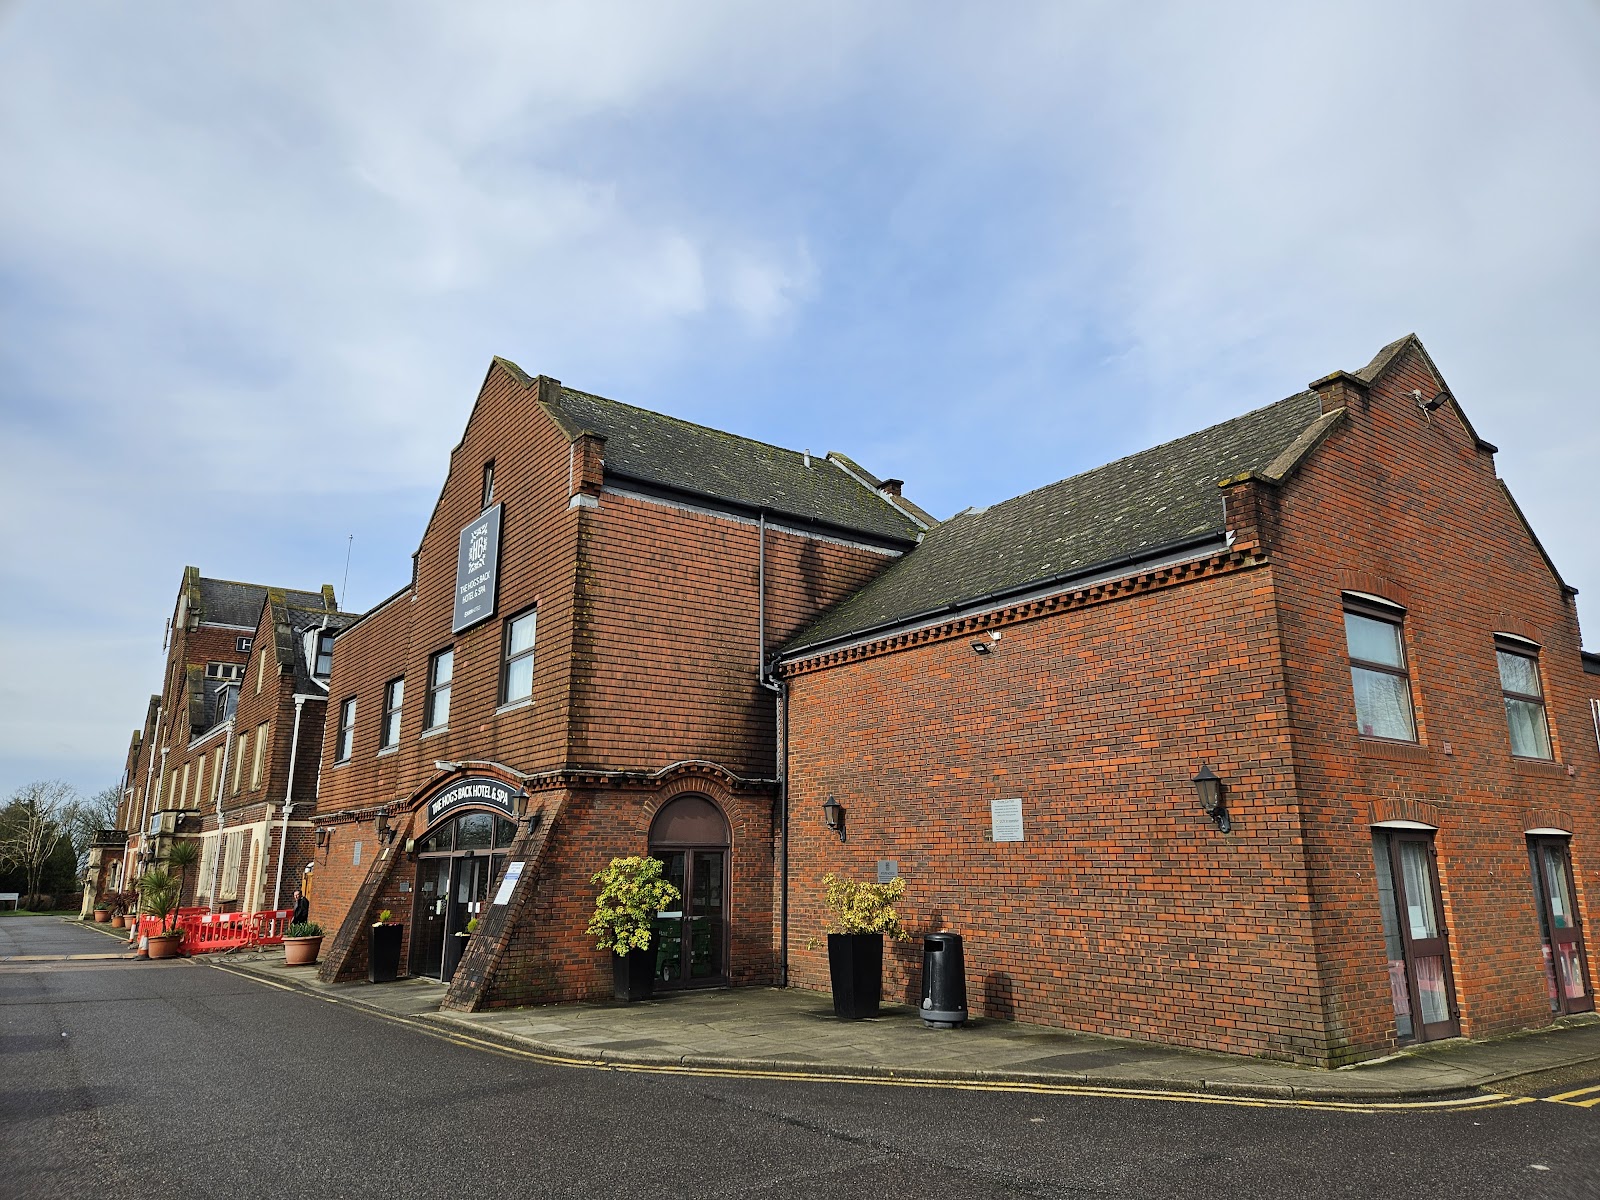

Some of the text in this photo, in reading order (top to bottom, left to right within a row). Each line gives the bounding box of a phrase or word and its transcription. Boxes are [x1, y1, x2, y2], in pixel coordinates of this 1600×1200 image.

[460, 571, 490, 594] THE HOG'S BACK
[462, 591, 474, 604] HOTEL
[478, 585, 486, 595] SPA
[432, 785, 508, 815] THE HOG'S BACK HOTEL & SPA
